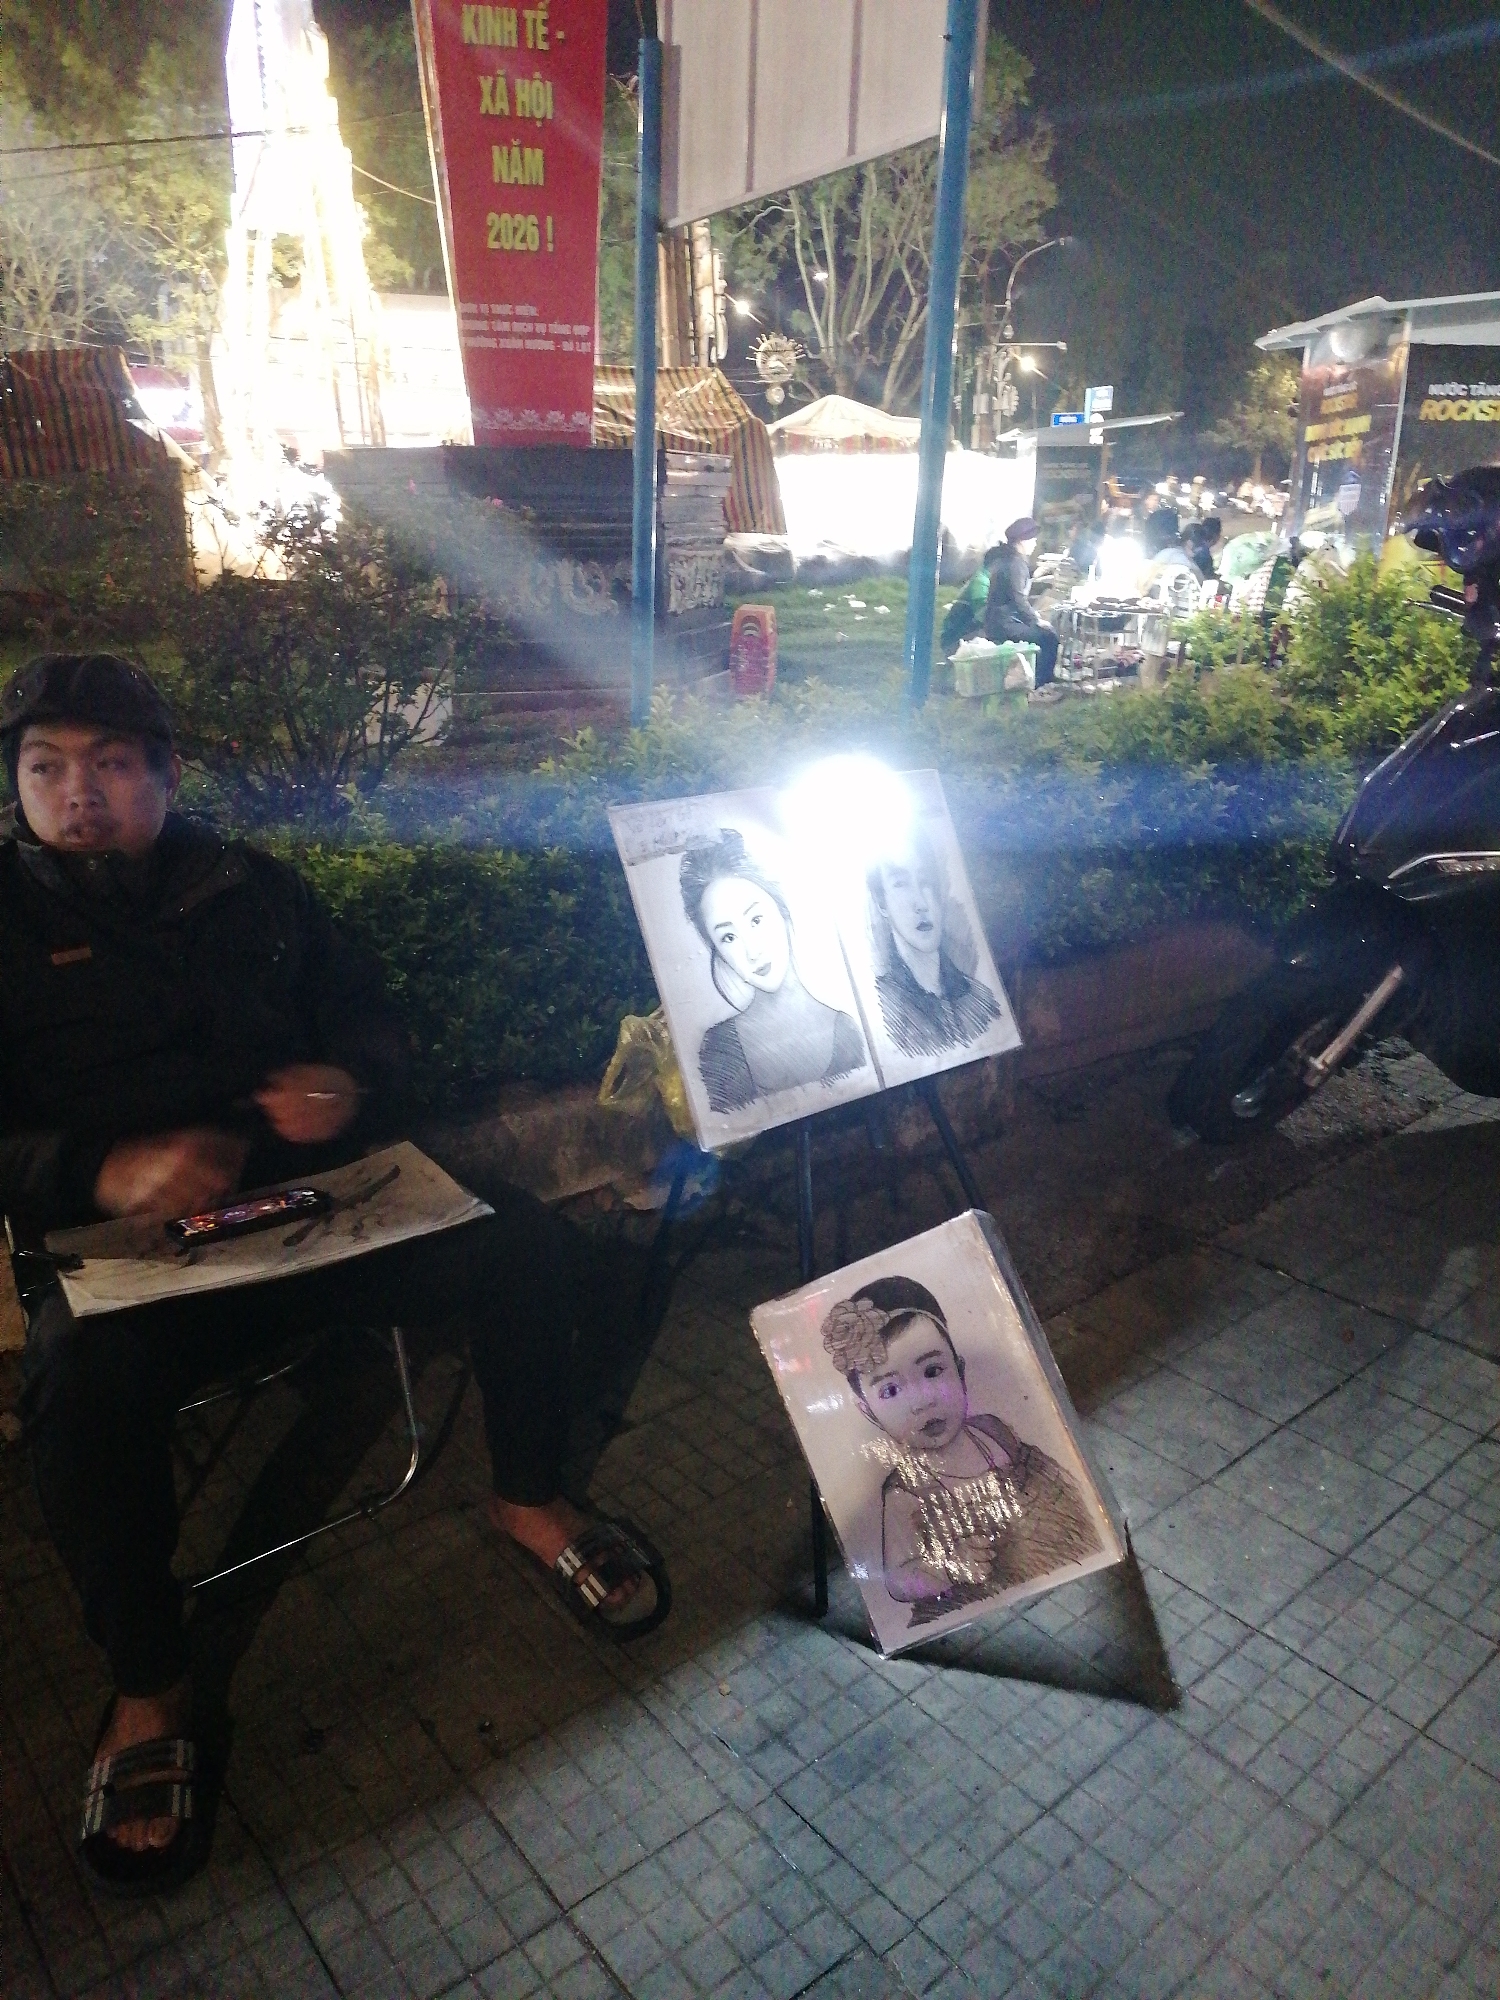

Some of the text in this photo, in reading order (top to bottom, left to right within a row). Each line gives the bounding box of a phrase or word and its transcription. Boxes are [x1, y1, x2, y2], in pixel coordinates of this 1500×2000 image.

[461, 4, 518, 48] KINH
[523, 0, 550, 51] TẾ
[478, 69, 554, 128] XÃ HỘI
[491, 138, 544, 186] NĂM
[486, 212, 540, 252] 2026
